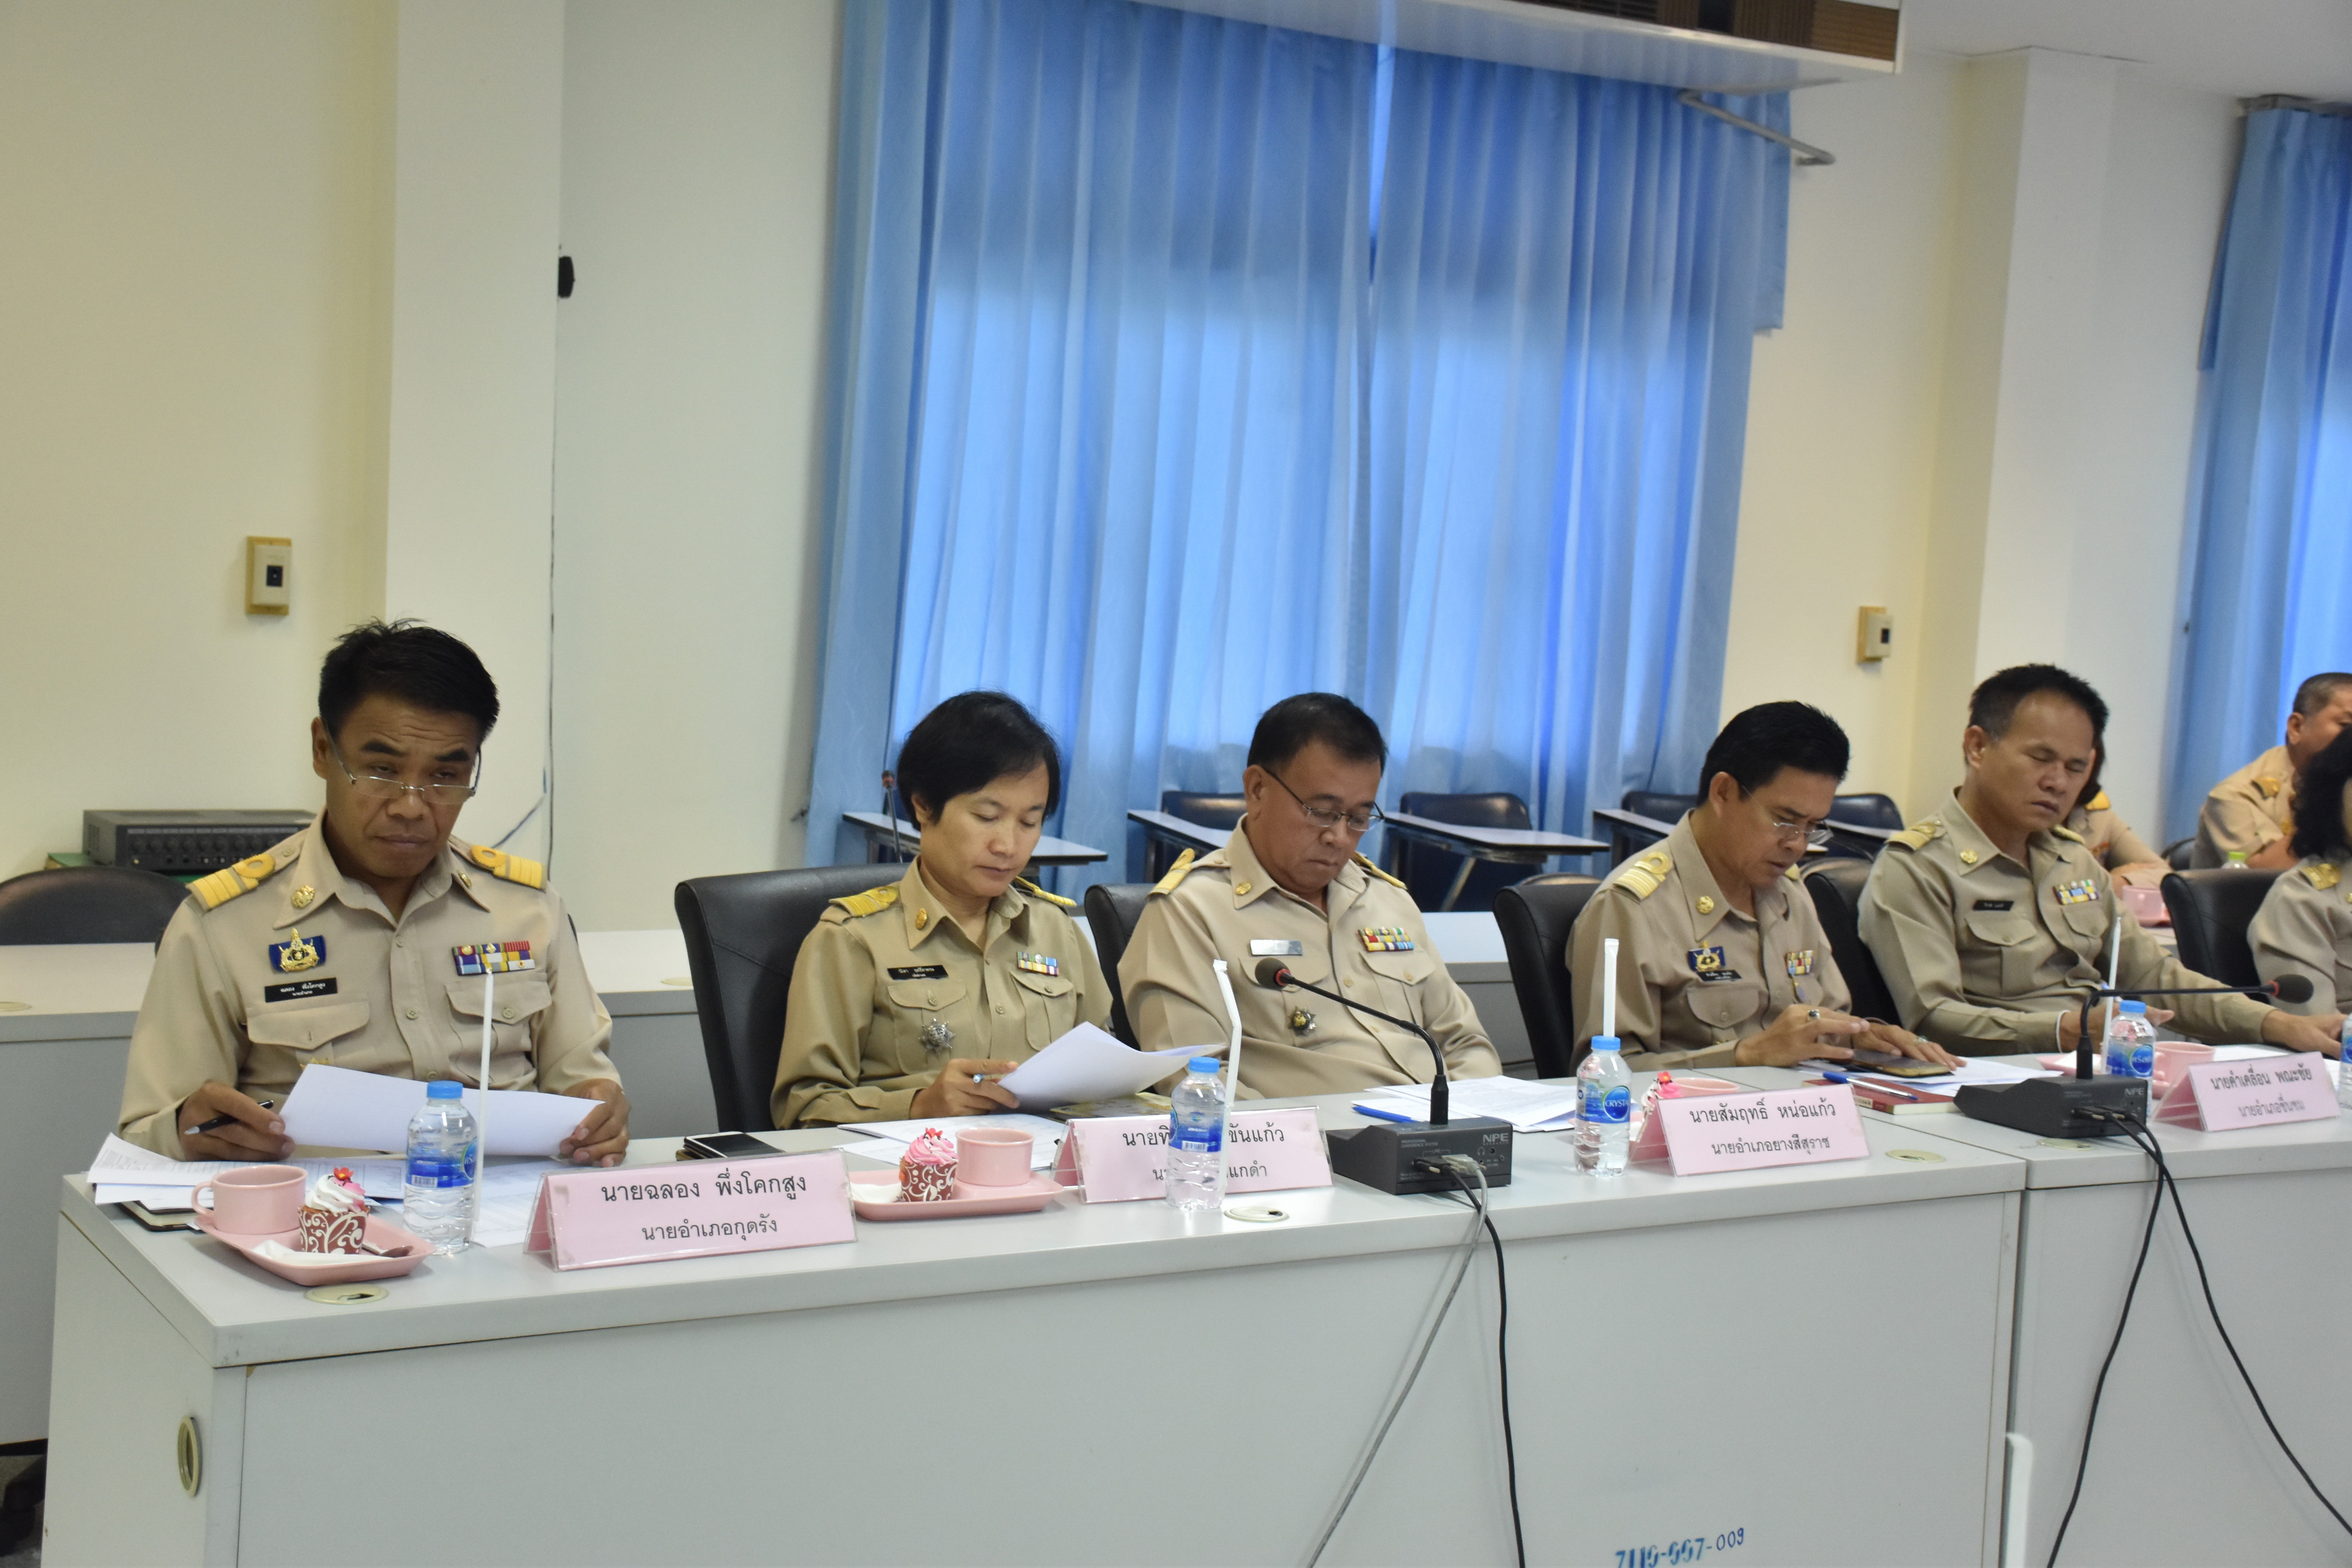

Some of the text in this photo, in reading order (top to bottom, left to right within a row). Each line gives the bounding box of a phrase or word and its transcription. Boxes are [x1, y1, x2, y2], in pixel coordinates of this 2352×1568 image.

[1690, 1097, 1836, 1124] นายสัมฤทธิ์ หน่อแก้ว
[1229, 1121, 1285, 1143] ขันแก้ว
[1483, 1133, 1509, 1143] NPE
[1711, 1134, 1830, 1155] นายอำเภอยางสีสุราช
[601, 1168, 807, 1202] นายฉลอง พึ่งโคกสูง
[642, 1212, 777, 1241] นายอำเภอกุดรัง
